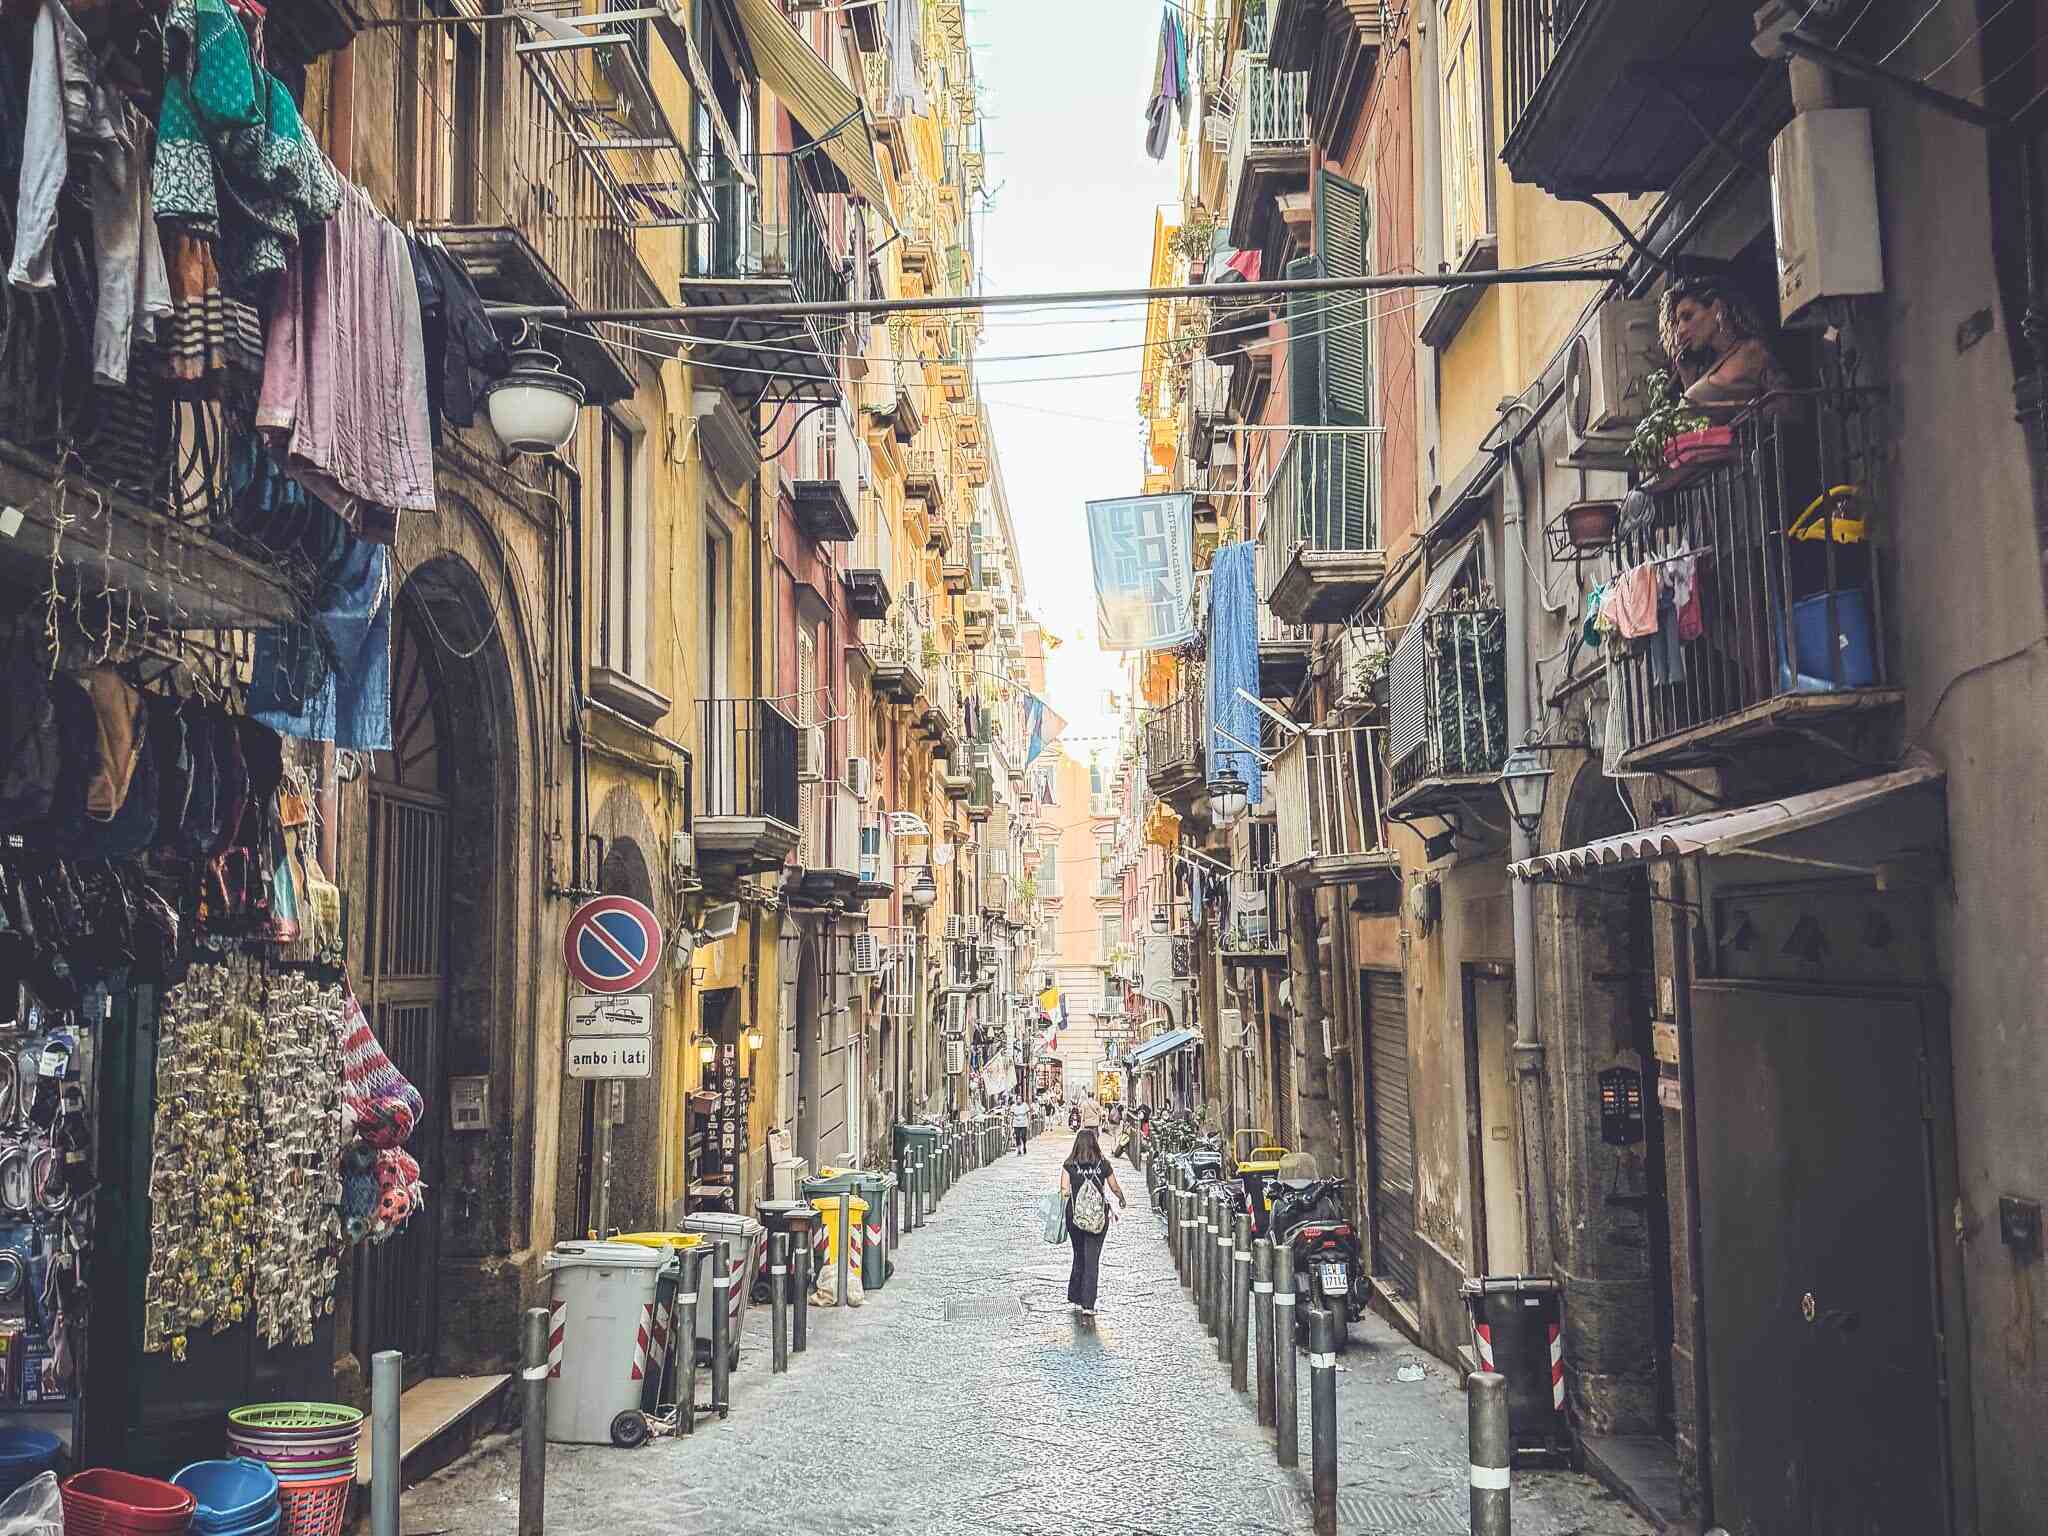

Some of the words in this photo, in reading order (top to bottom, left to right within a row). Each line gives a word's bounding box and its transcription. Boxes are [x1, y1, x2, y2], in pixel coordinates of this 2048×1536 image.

[573, 1051, 608, 1065] ambo
[613, 1051, 617, 1064] i
[622, 1050, 646, 1064] lati
